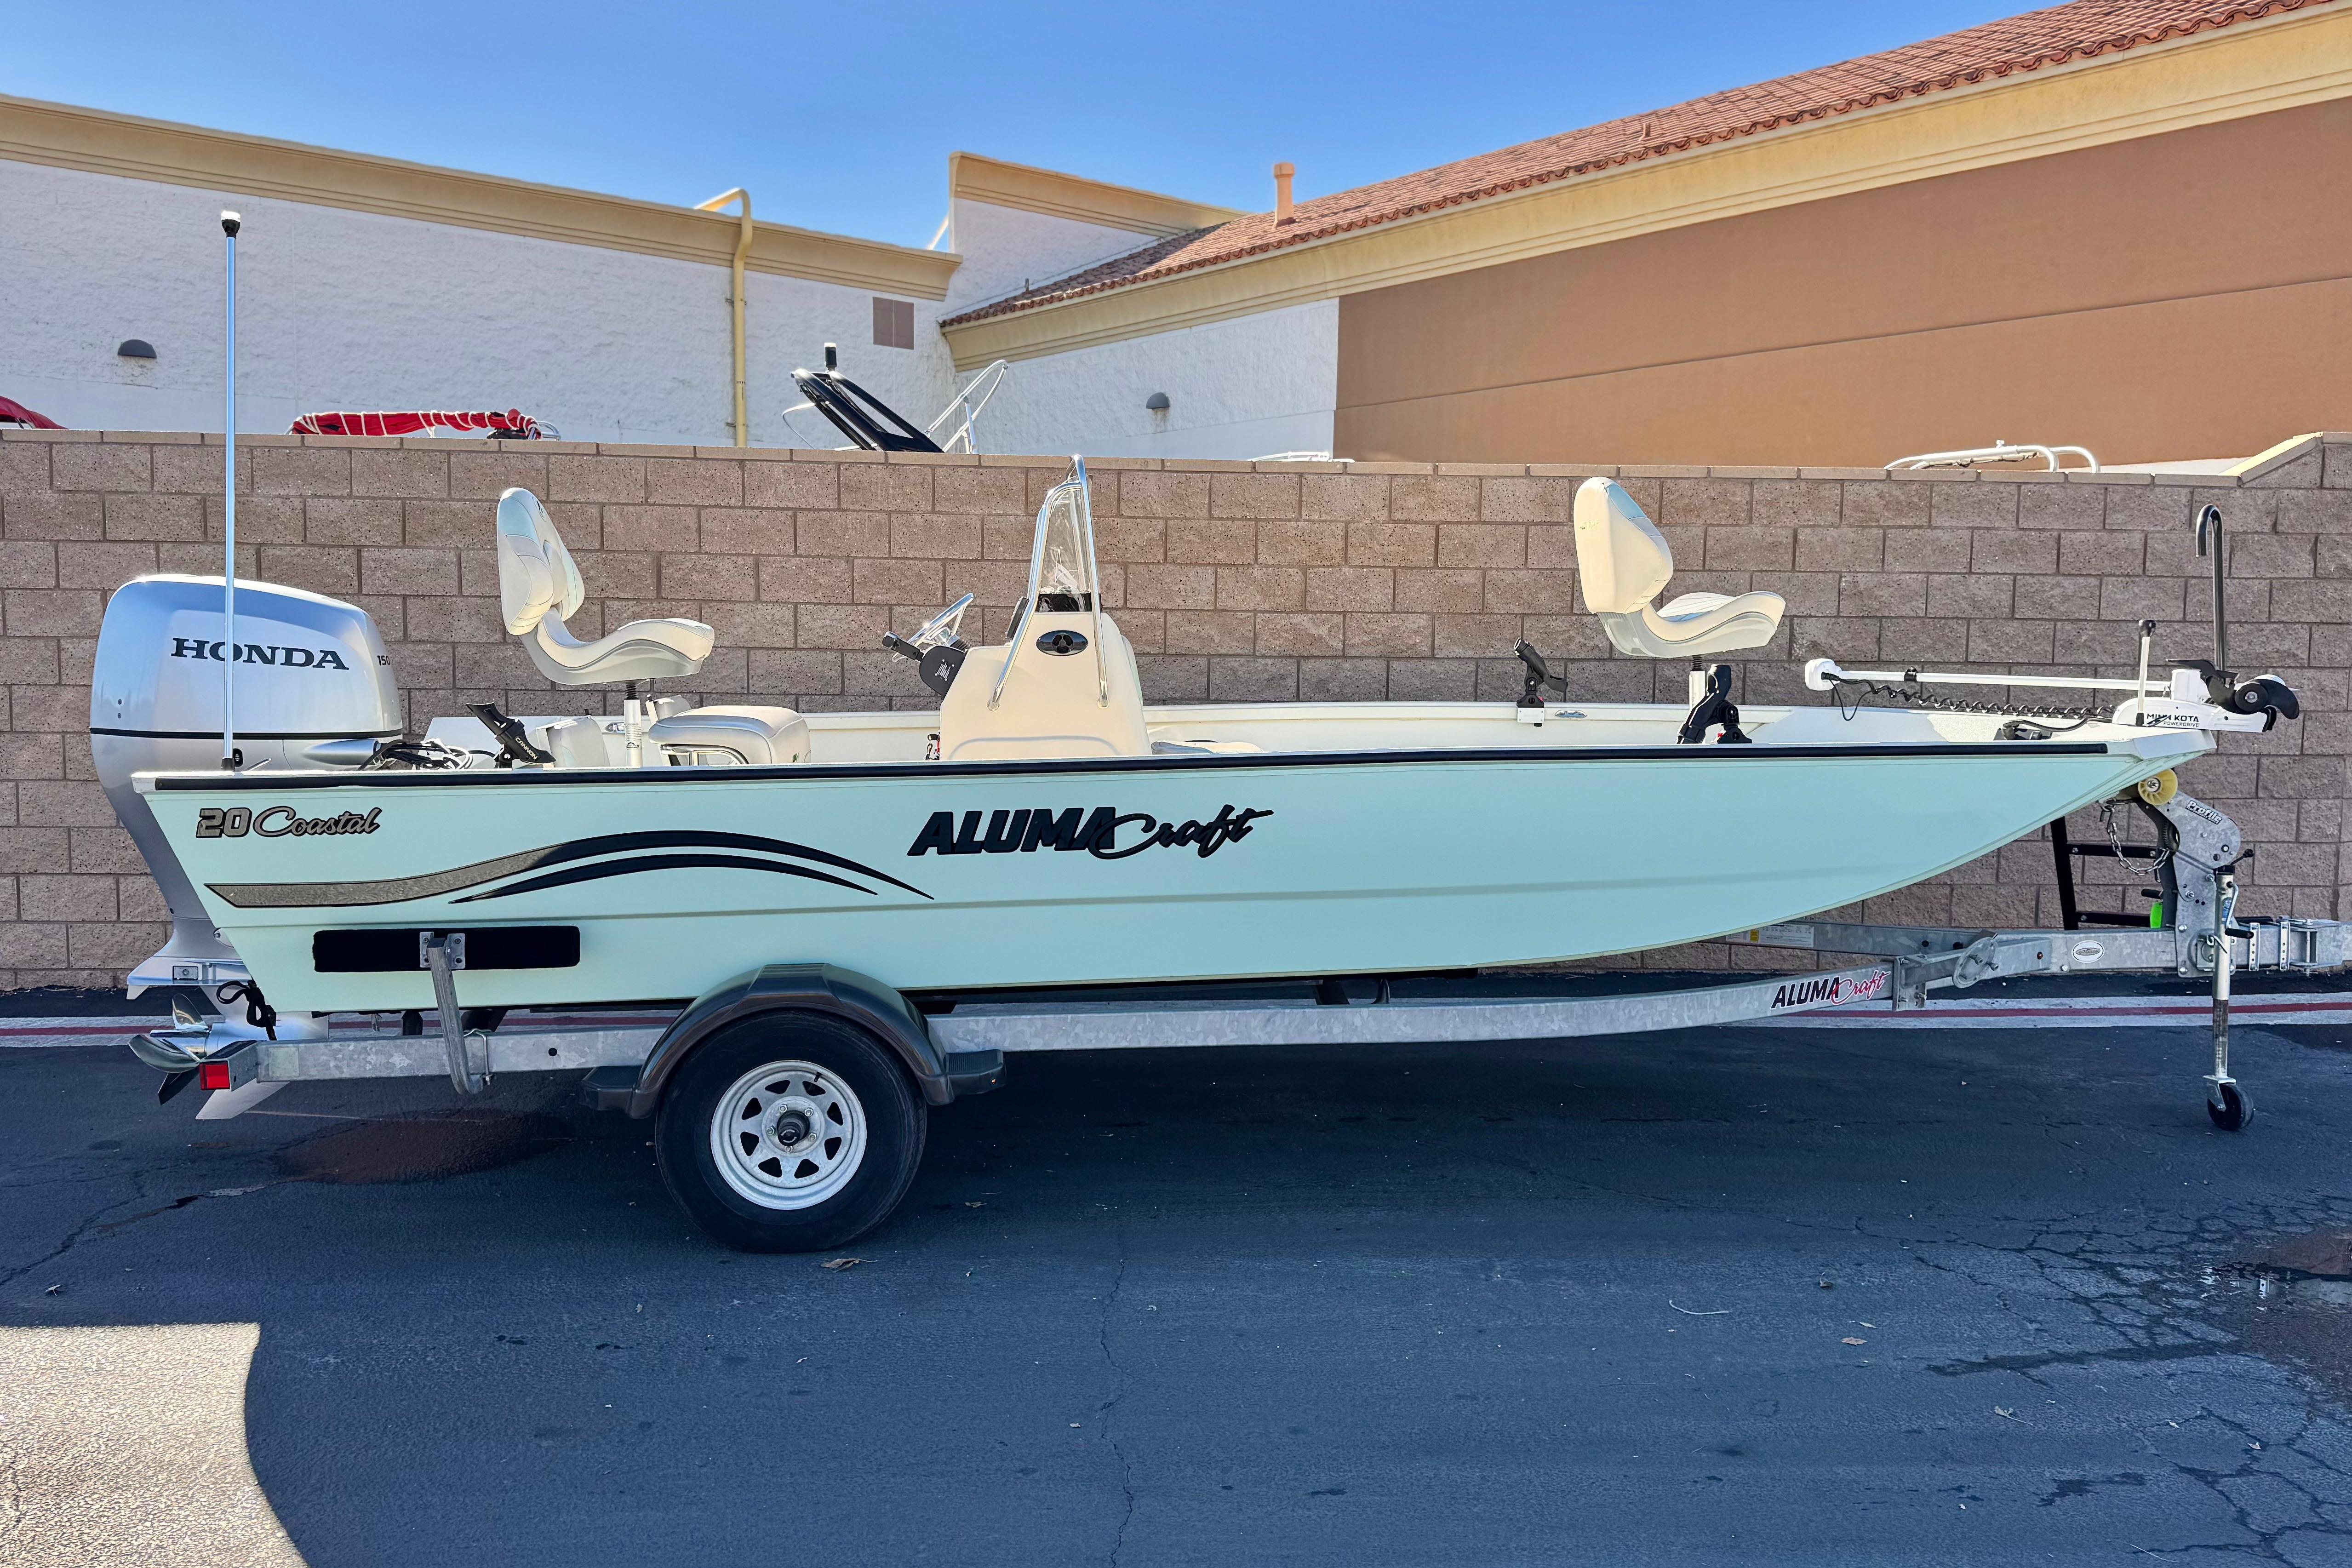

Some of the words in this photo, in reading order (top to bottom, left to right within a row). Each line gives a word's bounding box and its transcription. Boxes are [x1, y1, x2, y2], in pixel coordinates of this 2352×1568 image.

[171, 637, 349, 670] HONDA
[377, 655, 390, 666] 150
[515, 737, 538, 760] CANNON
[196, 807, 252, 838] 20
[252, 806, 383, 837] Coastal
[2186, 800, 2222, 824] Profile
